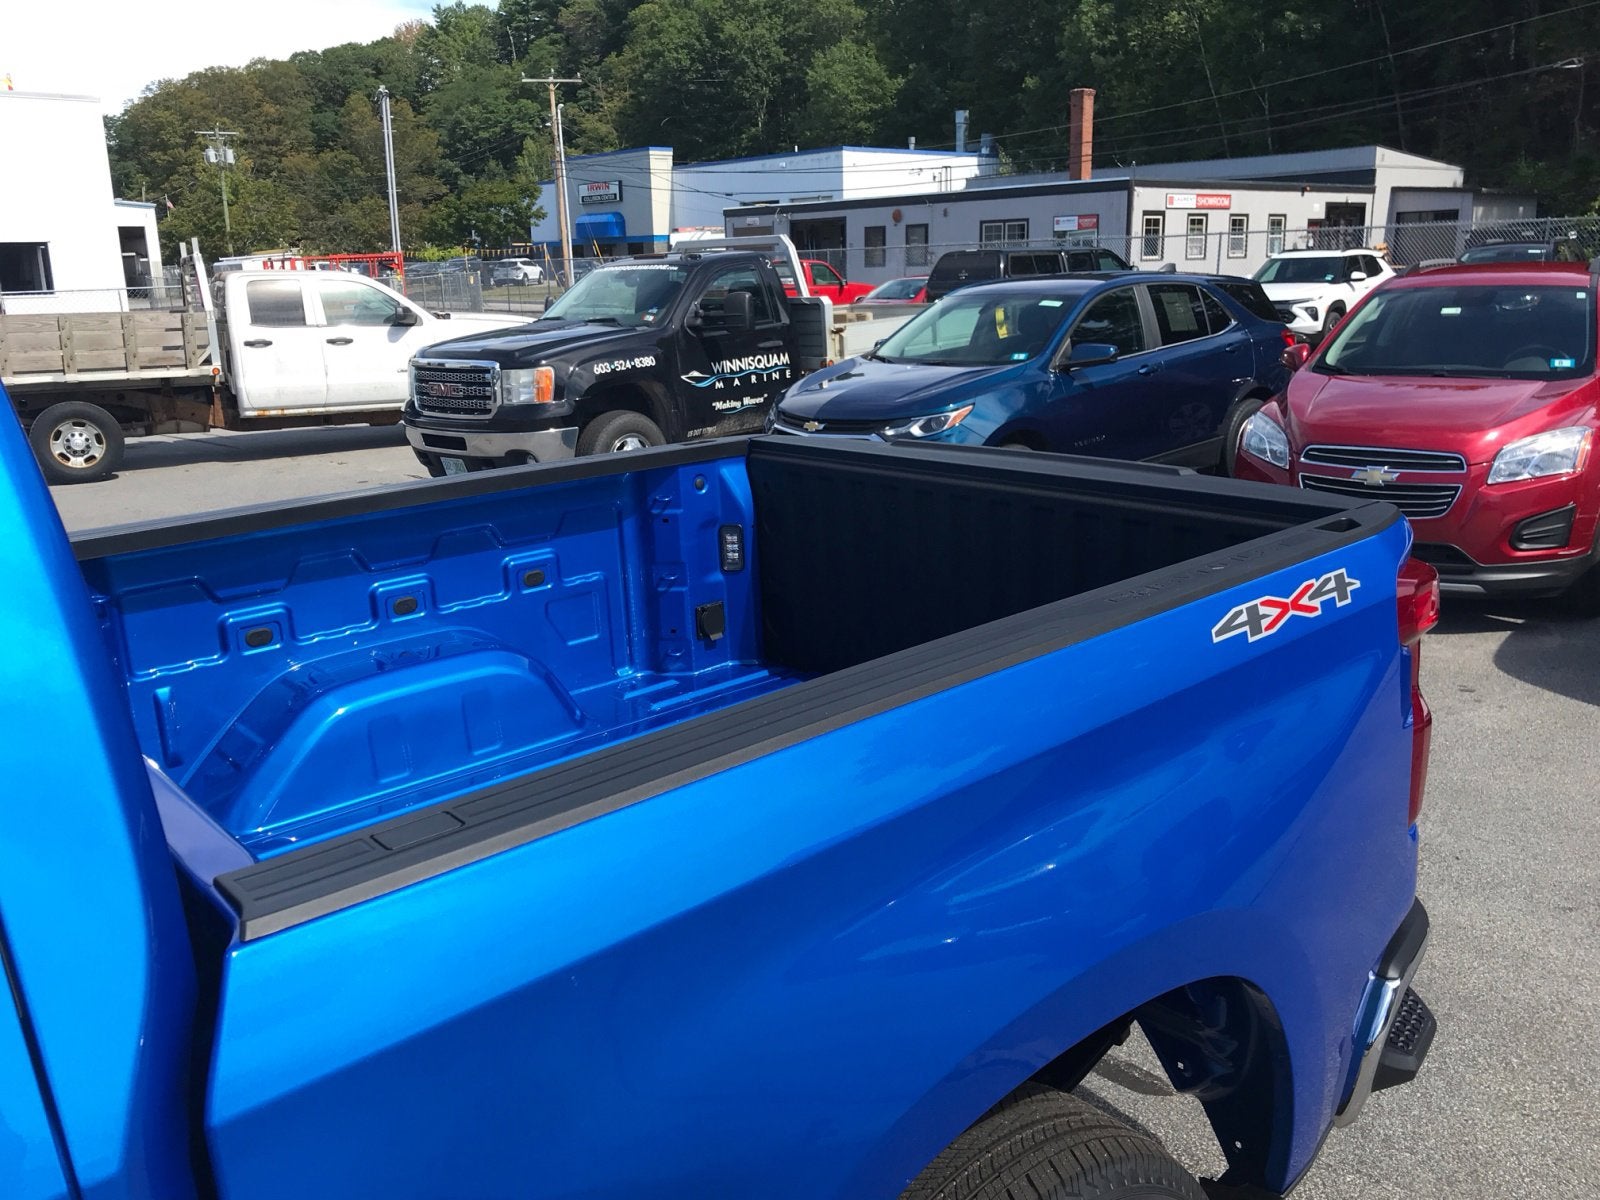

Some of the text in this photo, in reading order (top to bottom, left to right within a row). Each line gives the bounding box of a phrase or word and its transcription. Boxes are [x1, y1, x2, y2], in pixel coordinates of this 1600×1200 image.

[587, 182, 609, 191] IRWIN
[1197, 197, 1231, 206] SHOWROOM
[765, 260, 773, 269] 2
[711, 352, 790, 374] WINNISQUAM
[715, 370, 791, 389] MARINE
[428, 382, 463, 397] GMC
